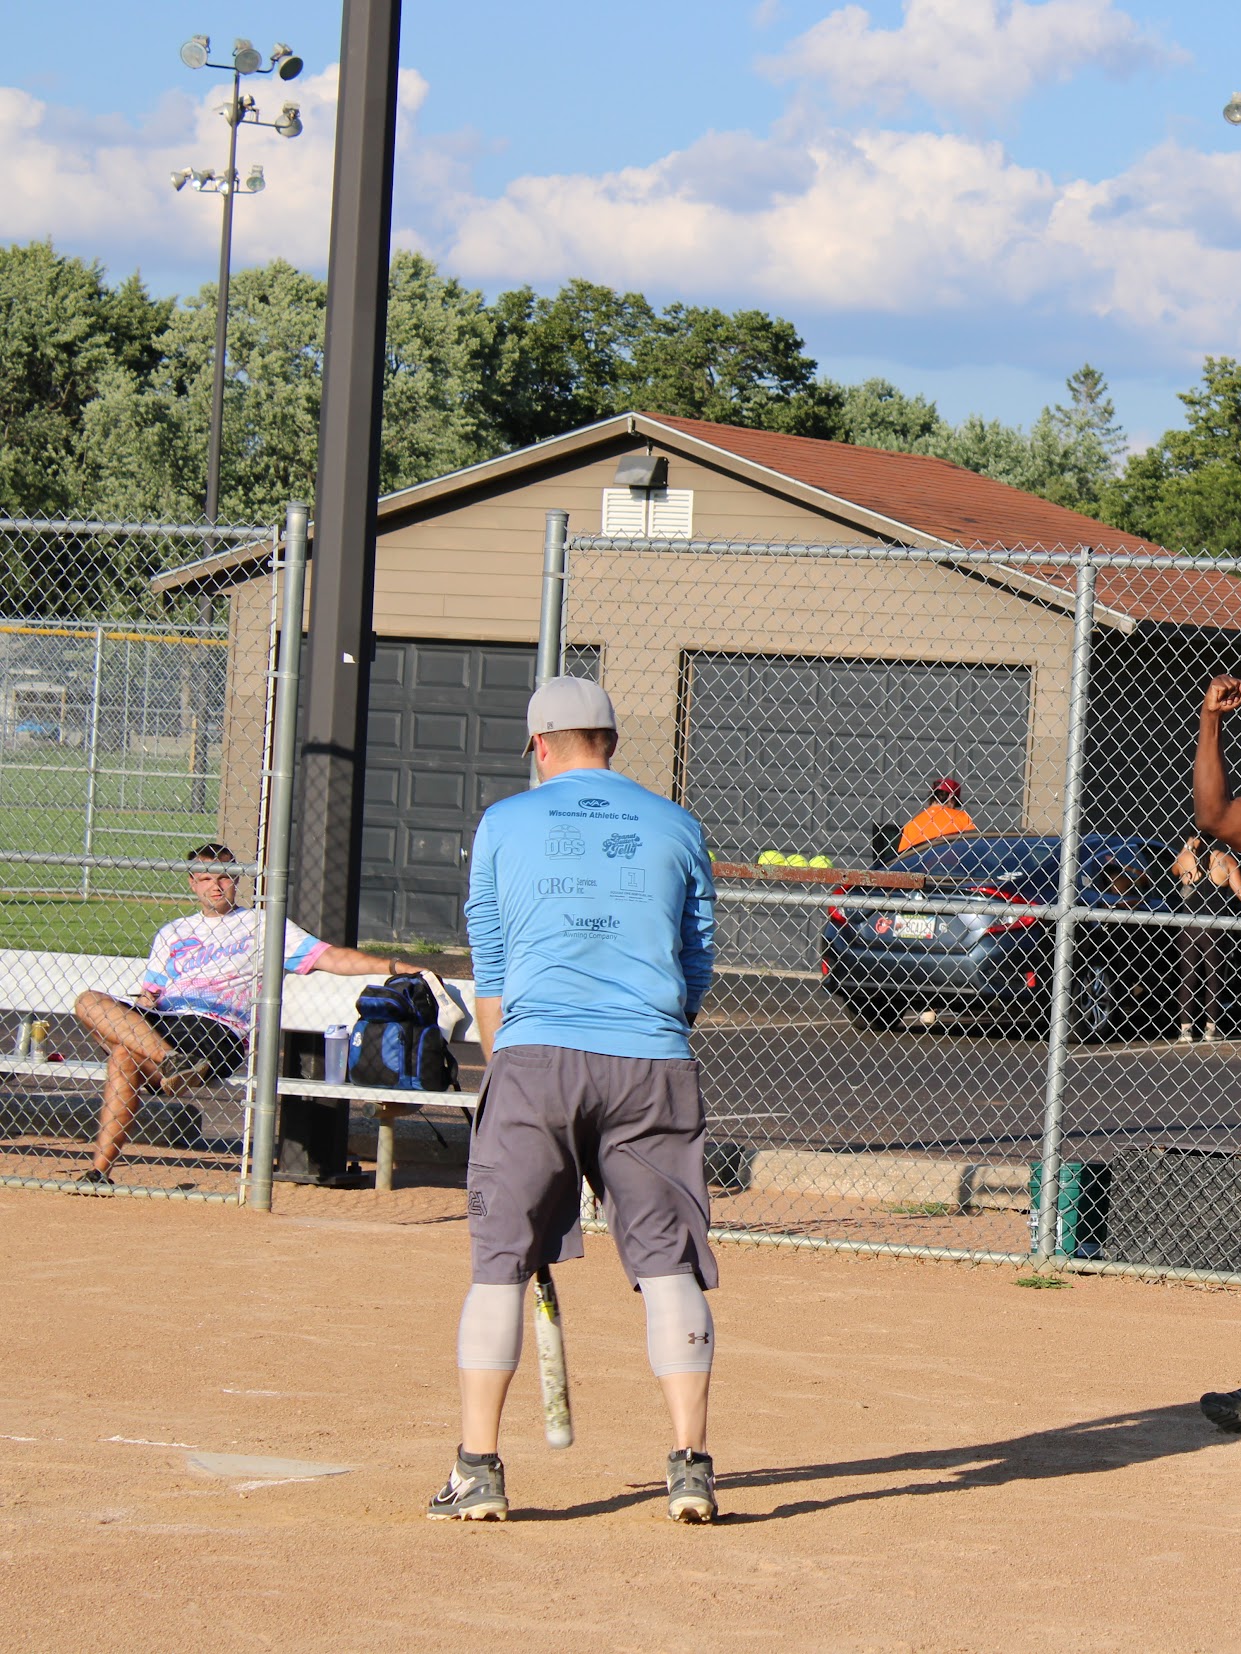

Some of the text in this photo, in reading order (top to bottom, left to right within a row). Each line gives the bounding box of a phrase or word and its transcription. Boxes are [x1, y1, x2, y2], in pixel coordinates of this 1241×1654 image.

[549, 810, 639, 821] Wisconsin Athletic Club
[545, 839, 586, 856] DCS
[538, 877, 575, 895] CRG
[562, 913, 621, 932] Naegele
[563, 932, 618, 941] Awning Company
